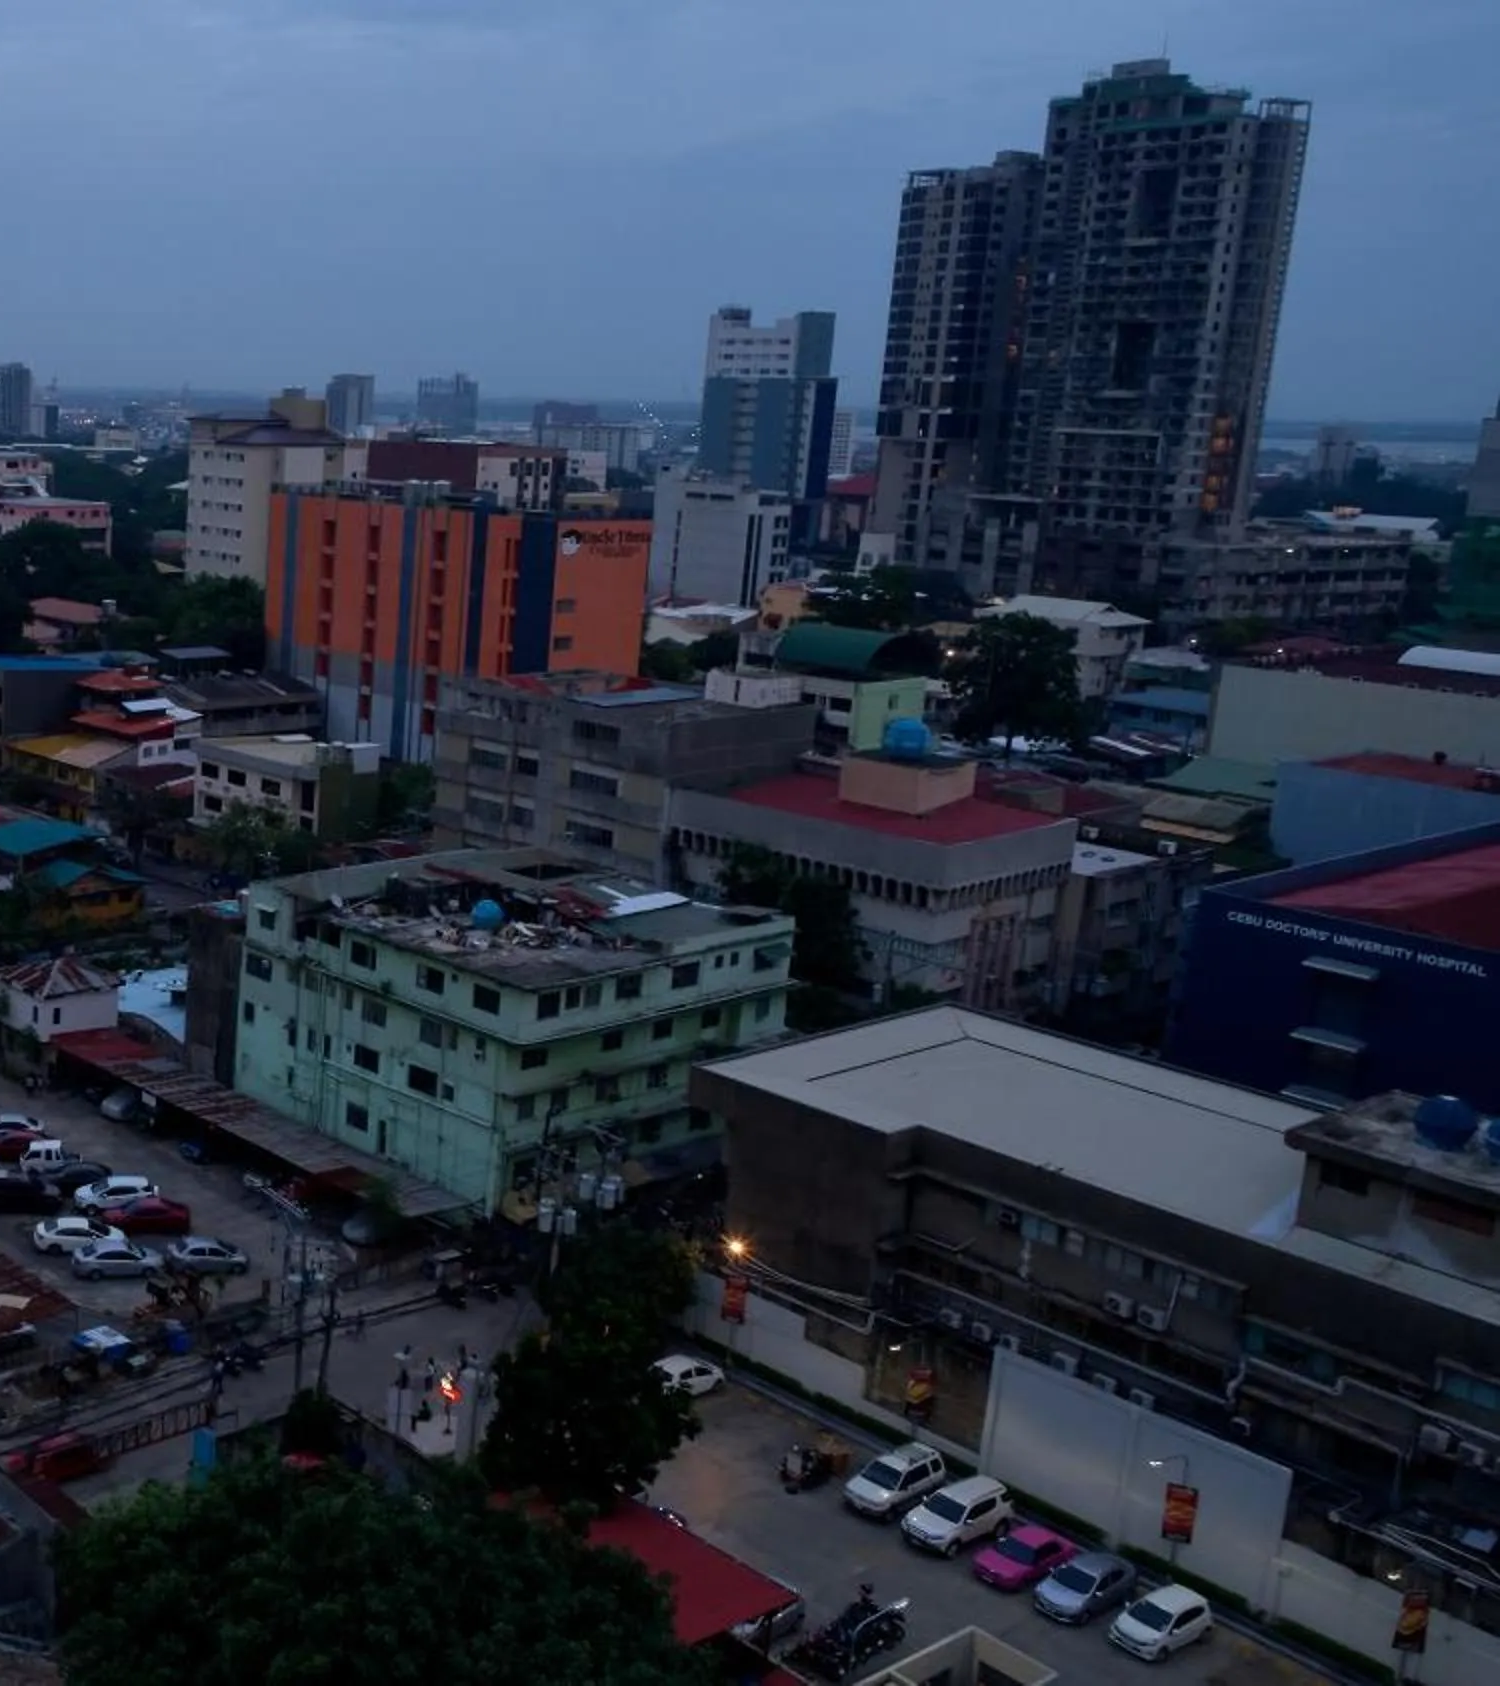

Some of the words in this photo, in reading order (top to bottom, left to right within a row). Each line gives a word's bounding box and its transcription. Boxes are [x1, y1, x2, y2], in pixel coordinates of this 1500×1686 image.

[1226, 911, 1262, 927] CEBU
[1333, 934, 1414, 962] UNIVERSITY
[1416, 952, 1487, 977] HOSPITAL
